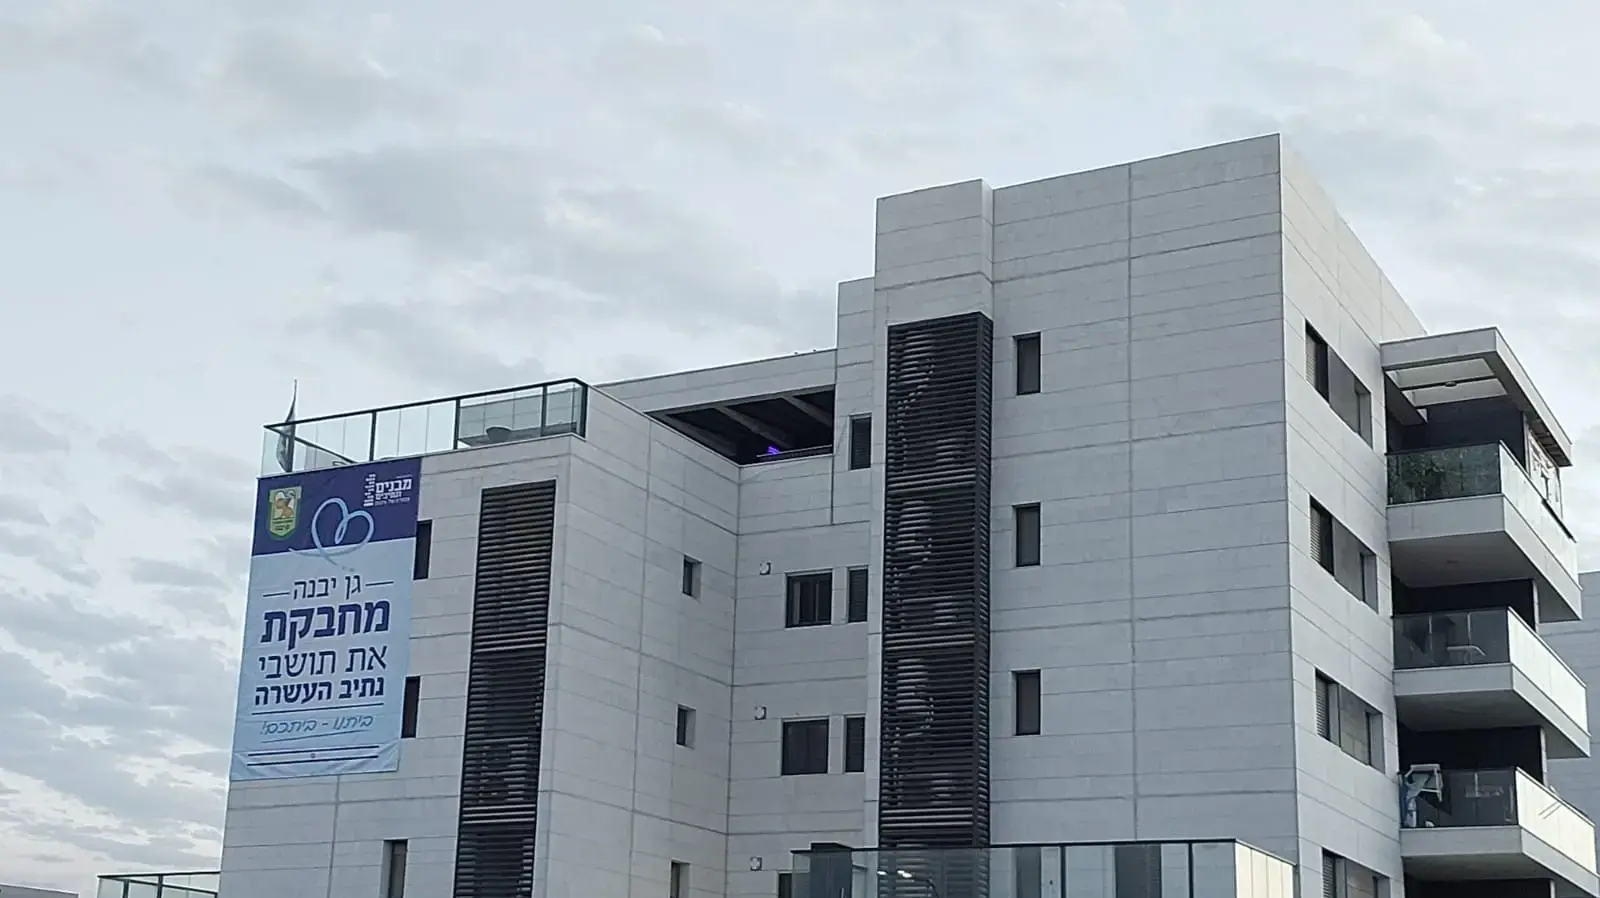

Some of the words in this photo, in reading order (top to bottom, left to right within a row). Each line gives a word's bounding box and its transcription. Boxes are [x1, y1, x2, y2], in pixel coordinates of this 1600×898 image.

[375, 479, 412, 493] מבנים
[293, 577, 336, 600] יבנה
[345, 575, 361, 600] גן
[260, 600, 390, 651] מחבקת
[258, 651, 336, 679] תושבי
[345, 645, 387, 672] את
[255, 682, 332, 706] העשרה
[338, 677, 384, 699] נתיב
[333, 715, 374, 730] ביתנו
